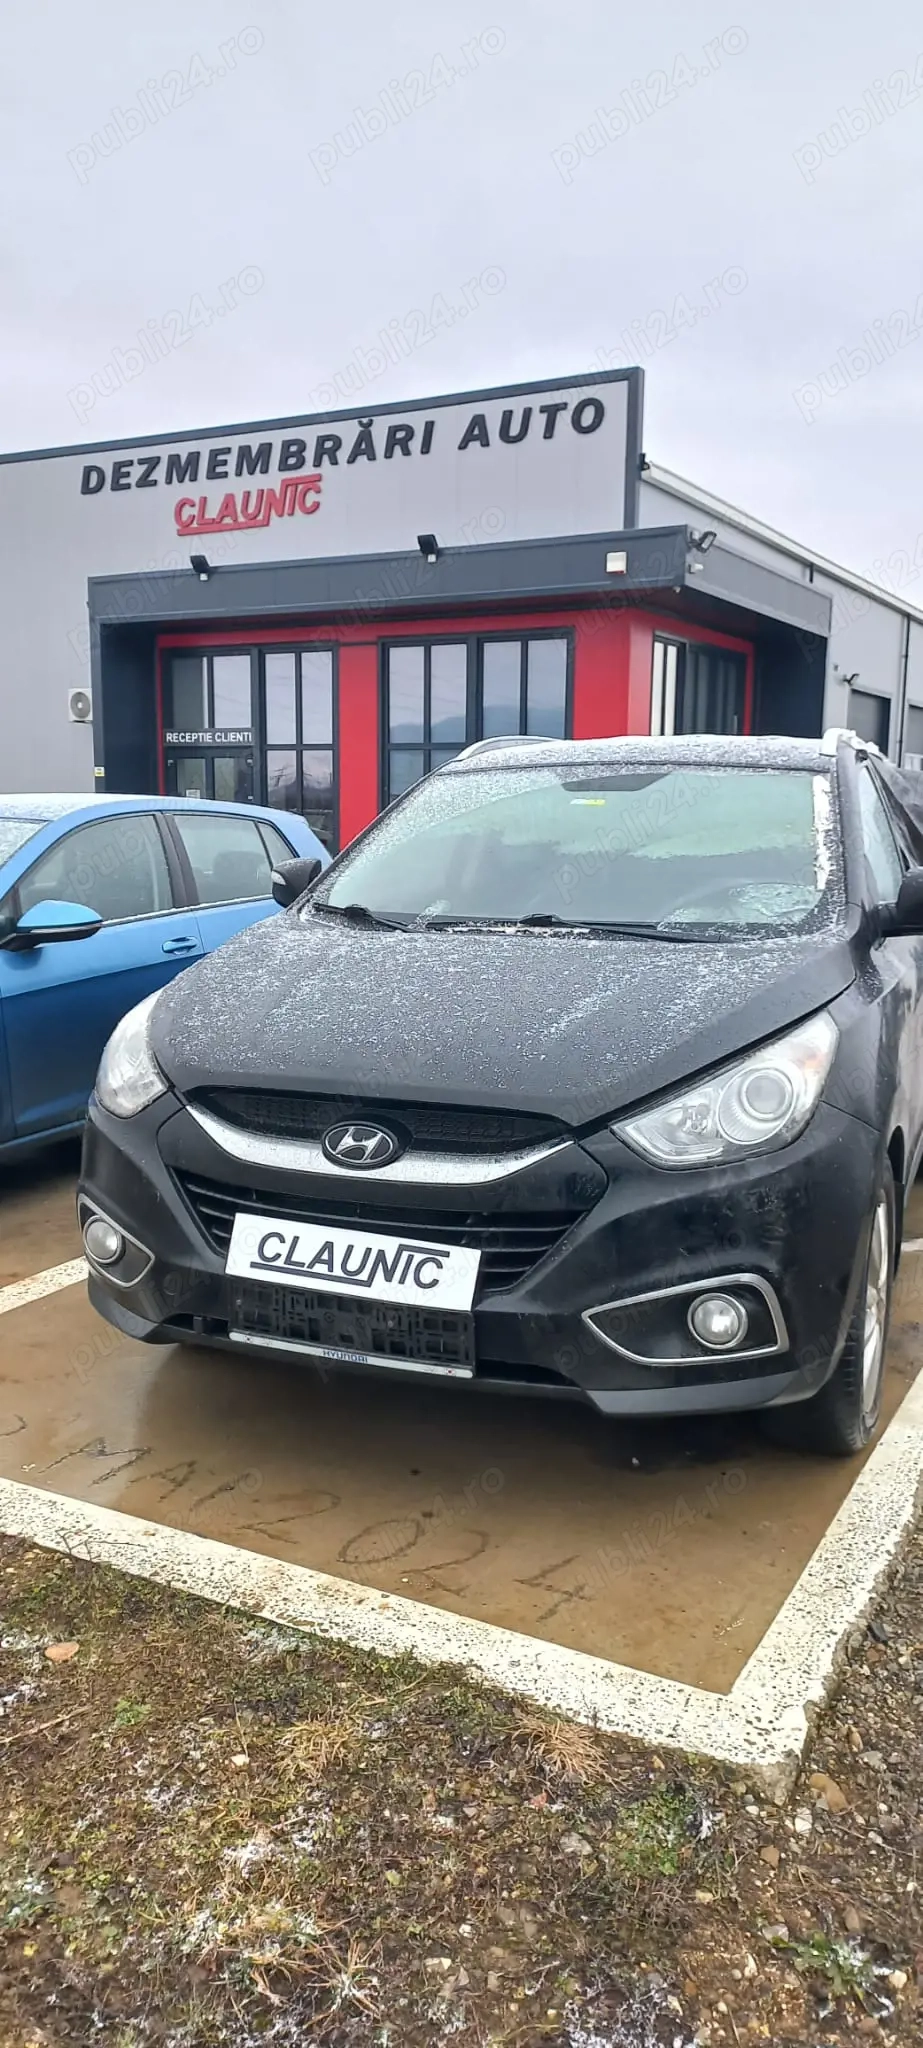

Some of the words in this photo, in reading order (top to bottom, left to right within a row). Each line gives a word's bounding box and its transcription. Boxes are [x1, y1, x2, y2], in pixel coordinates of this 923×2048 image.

[80, 418, 435, 495] DEZMEMBRĂRI
[458, 397, 605, 450] AUTO
[174, 473, 322, 536] CLAUNIC
[166, 732, 212, 743] RECEPTIE
[215, 732, 252, 743] CLIENTI
[250, 1231, 450, 1289] CLAUNIC
[323, 1350, 368, 1363] HYUNDAI
